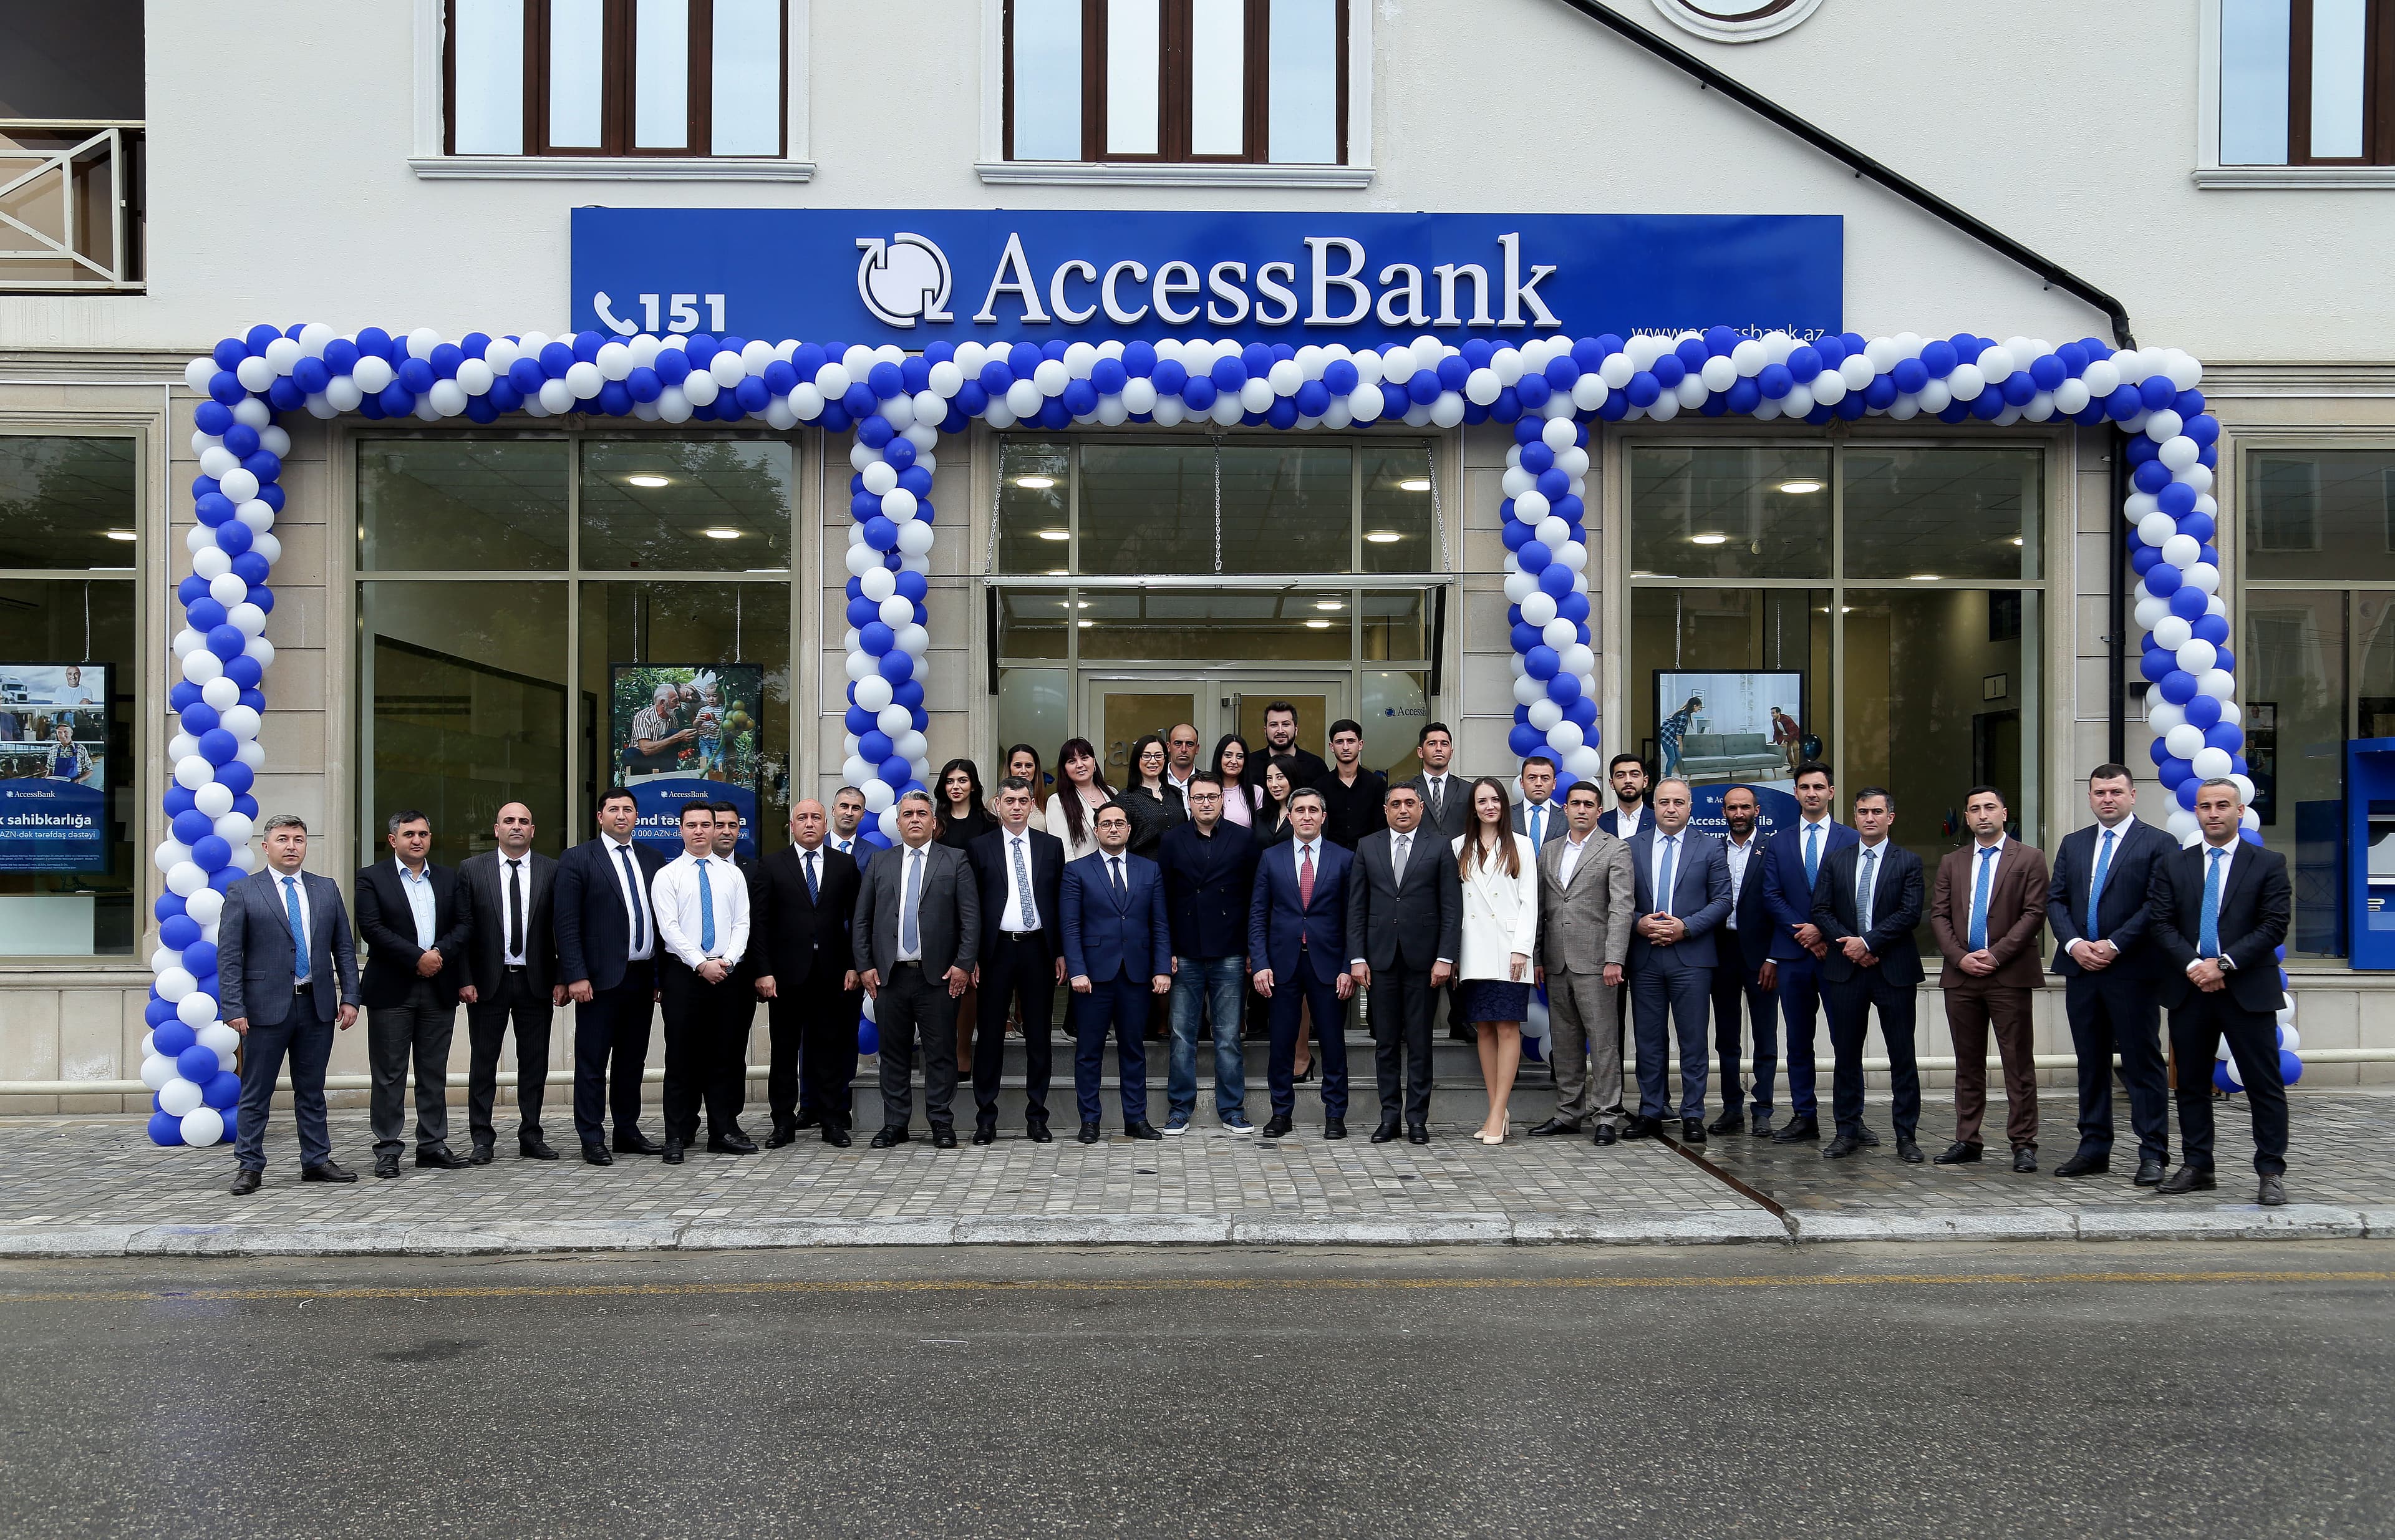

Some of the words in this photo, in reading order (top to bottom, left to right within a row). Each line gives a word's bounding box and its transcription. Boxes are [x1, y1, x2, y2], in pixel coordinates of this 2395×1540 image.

[972, 231, 1562, 327] AccessBank
[638, 293, 725, 332] 151
[7, 813, 92, 828] sahibkarlığa
[635, 814, 657, 826] ənd
[1687, 816, 1756, 826] Access
[1759, 816, 1773, 825] ilə
[35, 831, 66, 840] tərəfdaş
[68, 831, 95, 840] dəstəyi
